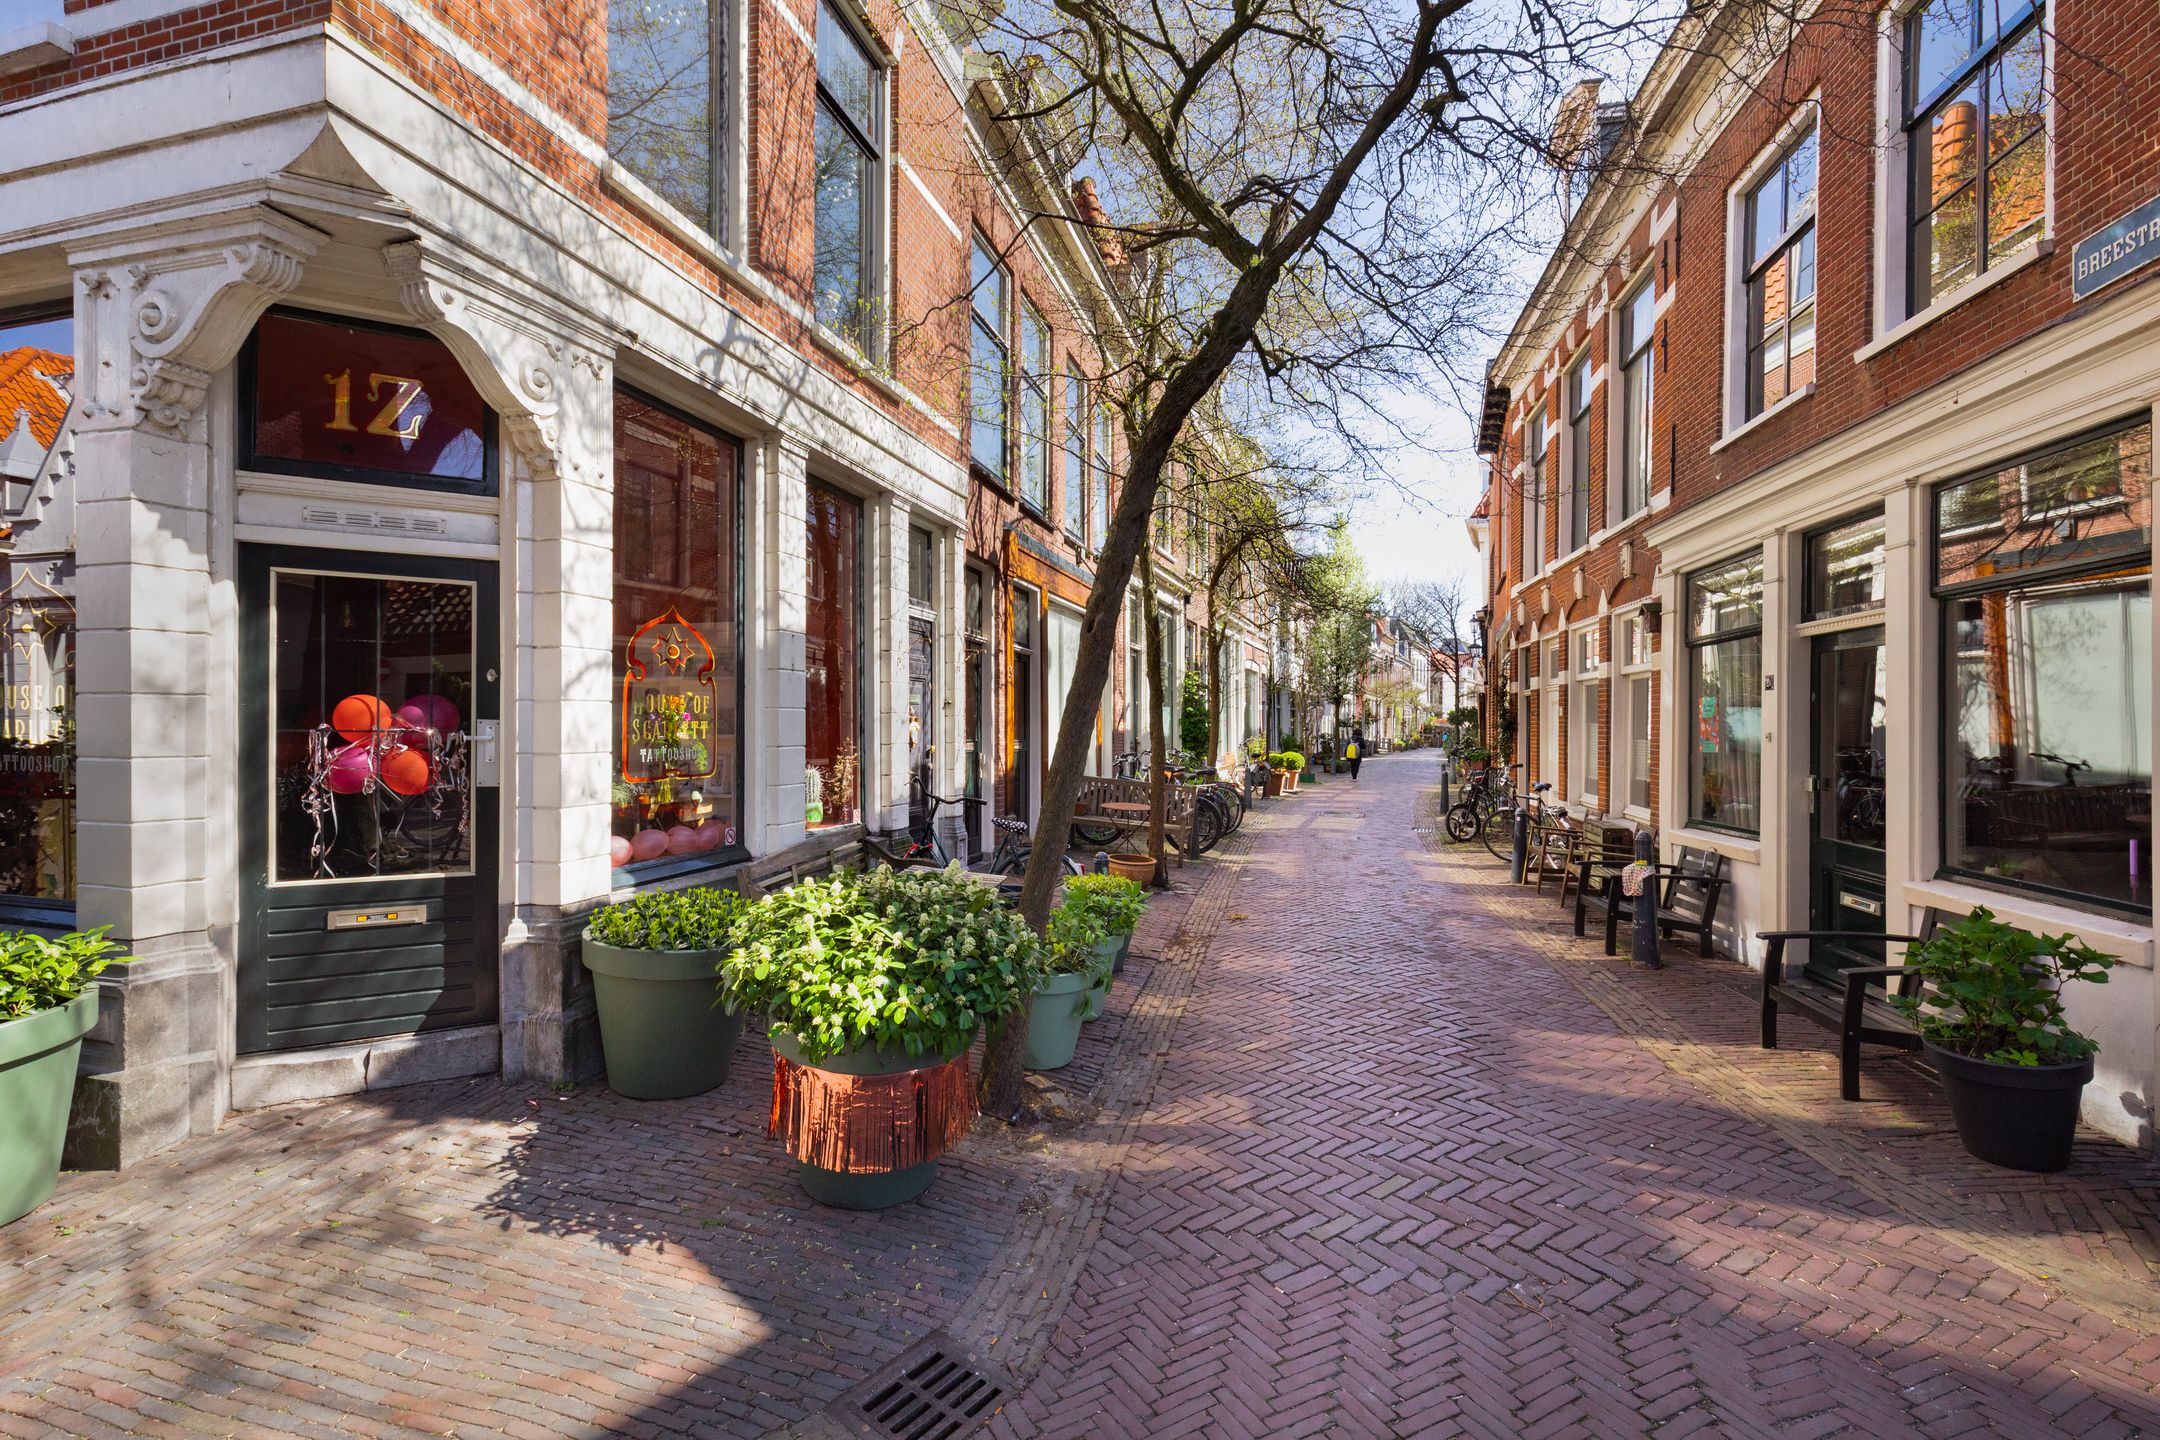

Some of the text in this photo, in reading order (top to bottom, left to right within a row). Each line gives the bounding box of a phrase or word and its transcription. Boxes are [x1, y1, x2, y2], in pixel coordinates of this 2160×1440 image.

[633, 693, 710, 716] HOUE OF
[0, 754, 68, 773] TTOOSHOP
[640, 746, 703, 763] TATTOOSHO
